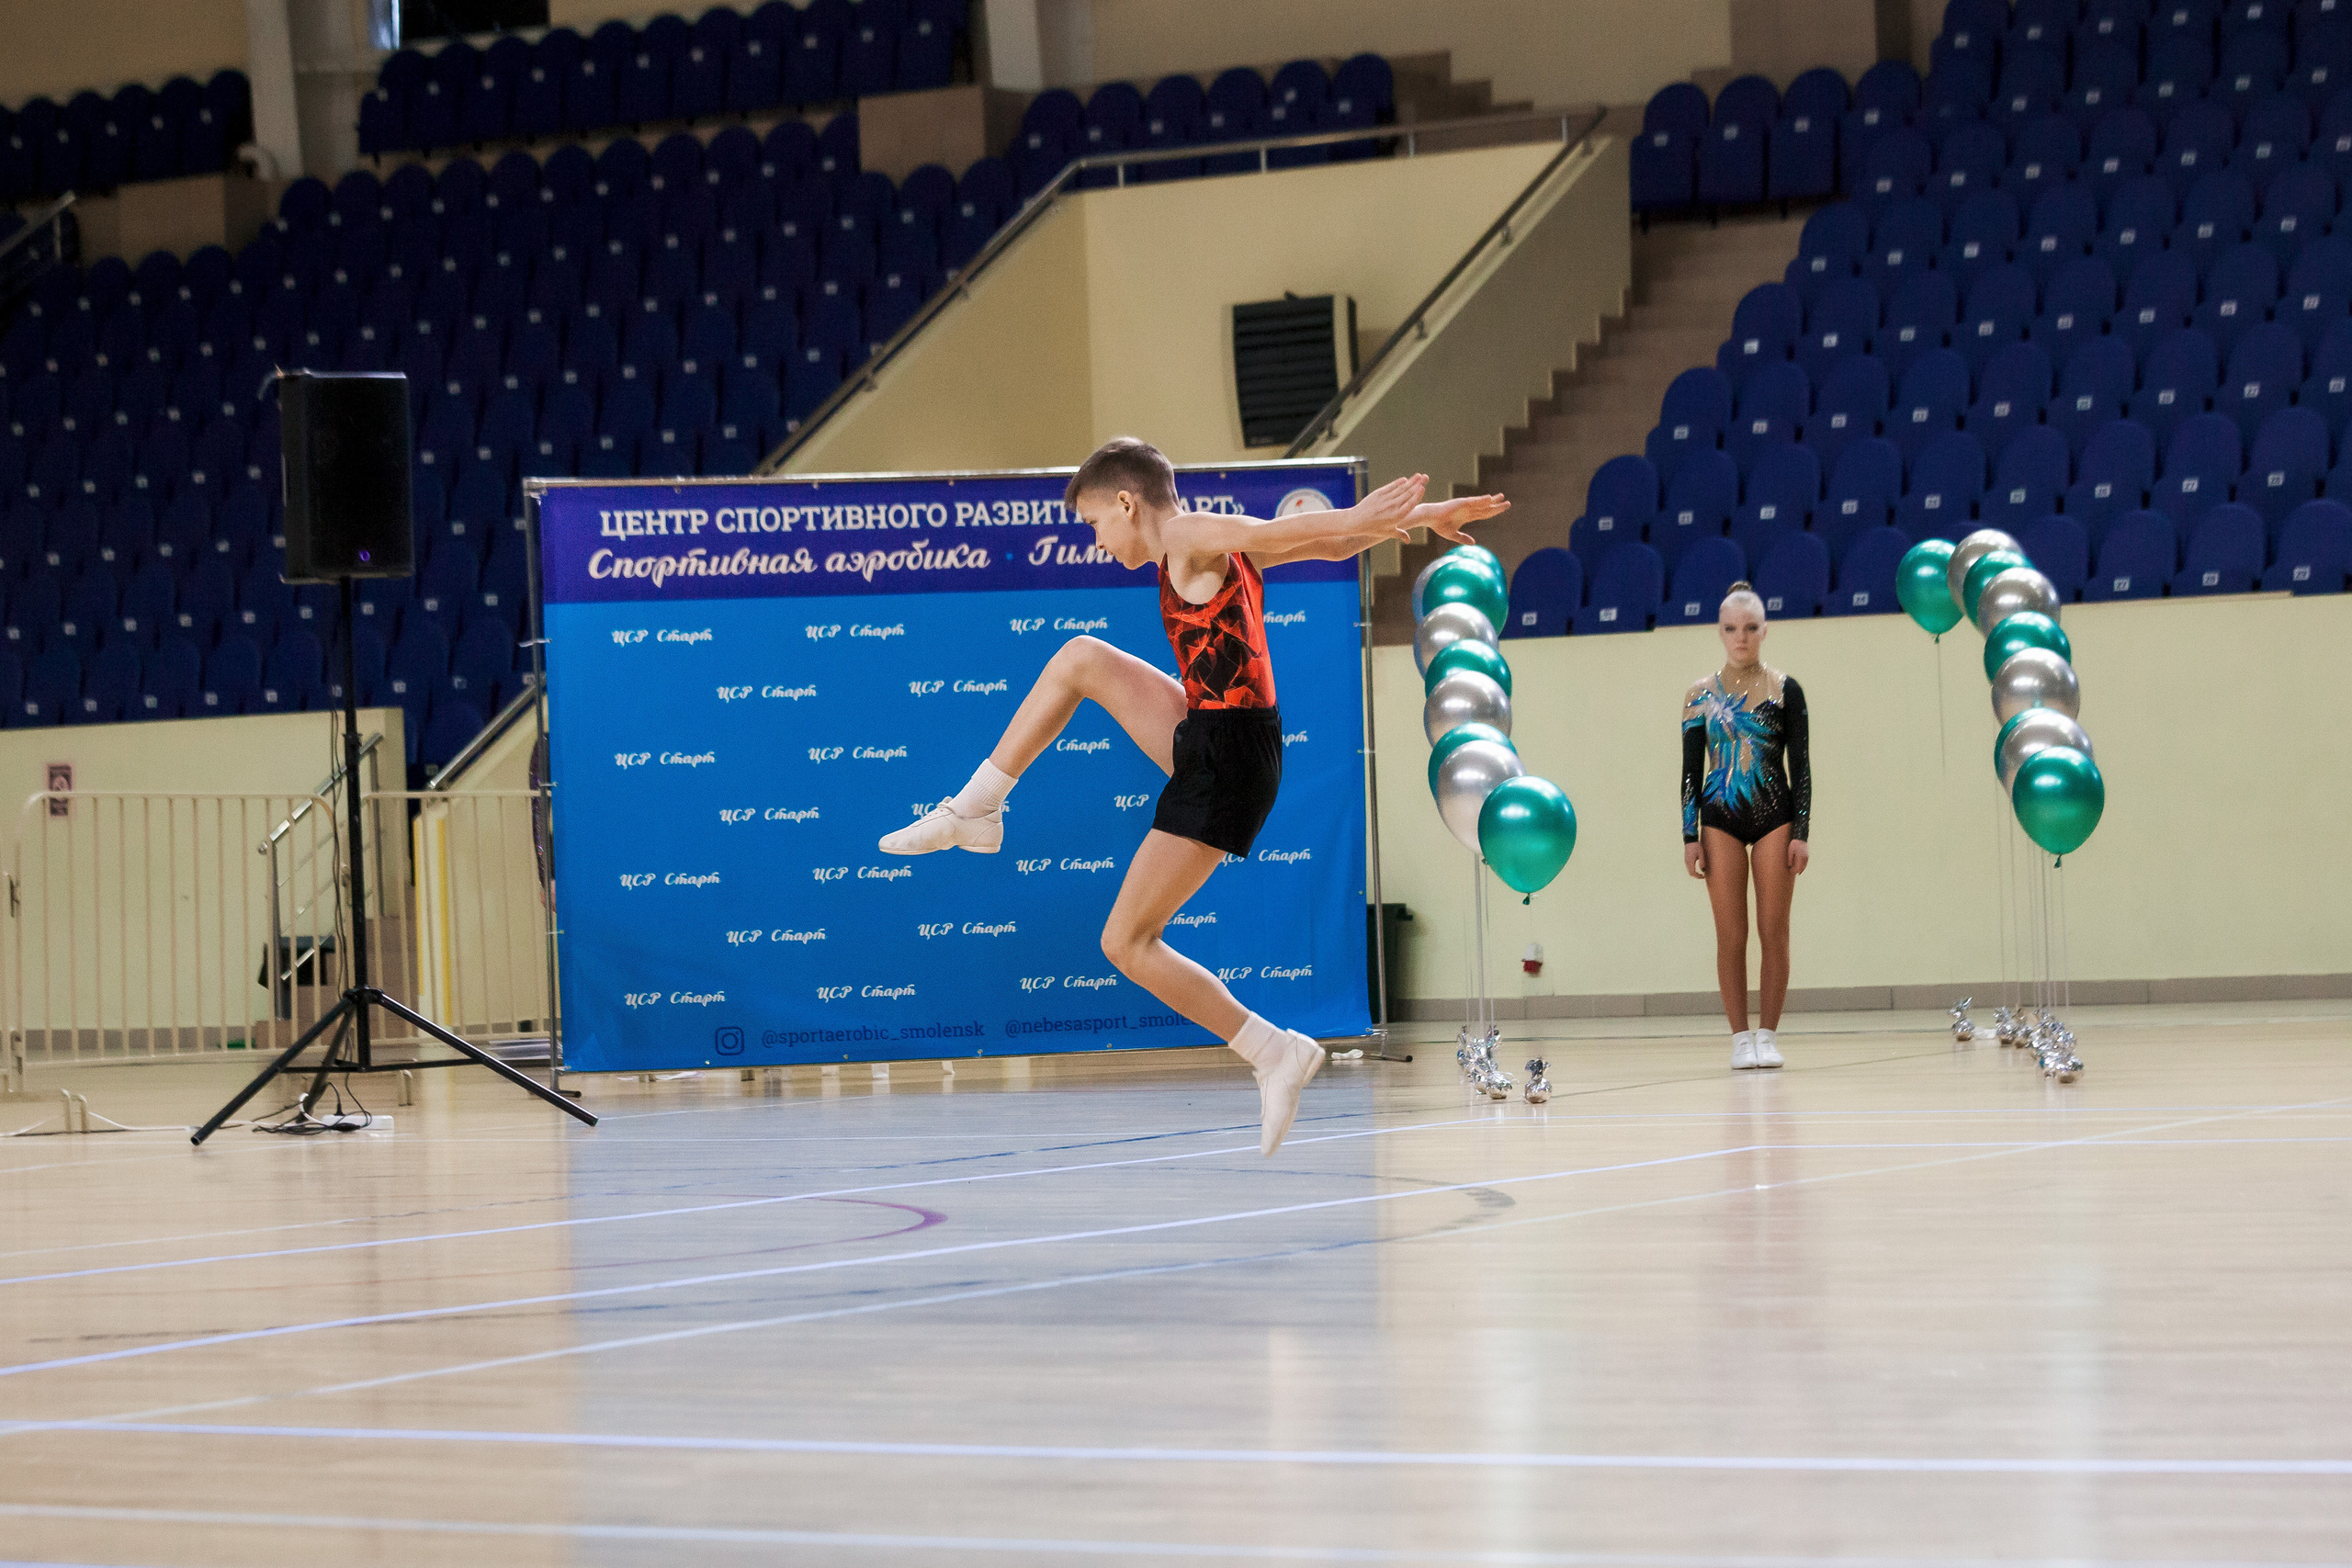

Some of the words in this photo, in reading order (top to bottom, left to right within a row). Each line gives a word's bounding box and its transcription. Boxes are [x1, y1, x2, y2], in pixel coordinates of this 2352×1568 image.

[599, 508, 709, 542] ЦЕНТР
[715, 502, 948, 535] СПОРТИВНОГО
[1179, 494, 1245, 514] АРТ»
[587, 547, 819, 589] Спортивная
[824, 538, 991, 583] аэробика
[1028, 535, 1122, 566] Гим
[1010, 617, 1046, 636] ЦСР
[1054, 617, 1108, 634] Старт
[1263, 610, 1306, 626] тарт
[611, 629, 649, 647] ЦСР
[656, 628, 713, 646] Старт
[805, 624, 842, 642] ЦСР
[849, 623, 905, 641] Старт
[716, 685, 753, 704] ЦСР
[761, 684, 817, 702] Старт
[909, 680, 945, 698] ЦСР
[953, 679, 1008, 696] Старт
[808, 746, 844, 764] ЦСР
[852, 745, 908, 762] Старт
[1056, 738, 1110, 754] Старт
[614, 751, 651, 770] ЦСР
[659, 750, 716, 768] Старт
[911, 803, 934, 818] ЦС
[1114, 794, 1149, 812] ЦСР
[718, 807, 756, 826] ЦСР
[763, 807, 820, 824] Старт
[1015, 858, 1052, 875] ЦСР
[1059, 856, 1114, 874] Старт
[1258, 848, 1311, 864] Старт
[619, 873, 657, 890] ЦСР
[664, 871, 720, 888] Старт
[812, 866, 849, 884] ЦСР
[857, 864, 912, 882] Старт
[1166, 912, 1217, 928] тарт
[726, 930, 763, 947] ЦСР
[771, 928, 826, 945] Старт
[917, 922, 954, 941] ЦСР
[962, 920, 1016, 938] Старт
[1217, 967, 1252, 984] ЦСР
[1260, 964, 1312, 981] Старт
[816, 986, 853, 1003] ЦСР
[861, 984, 915, 1000] Старт
[1019, 976, 1056, 994] ЦСР
[1063, 974, 1117, 991] Старт
[624, 992, 662, 1010] ЦСР
[670, 990, 725, 1007] Старт
[762, 1021, 985, 1048] @sportaerobic_smolensk
